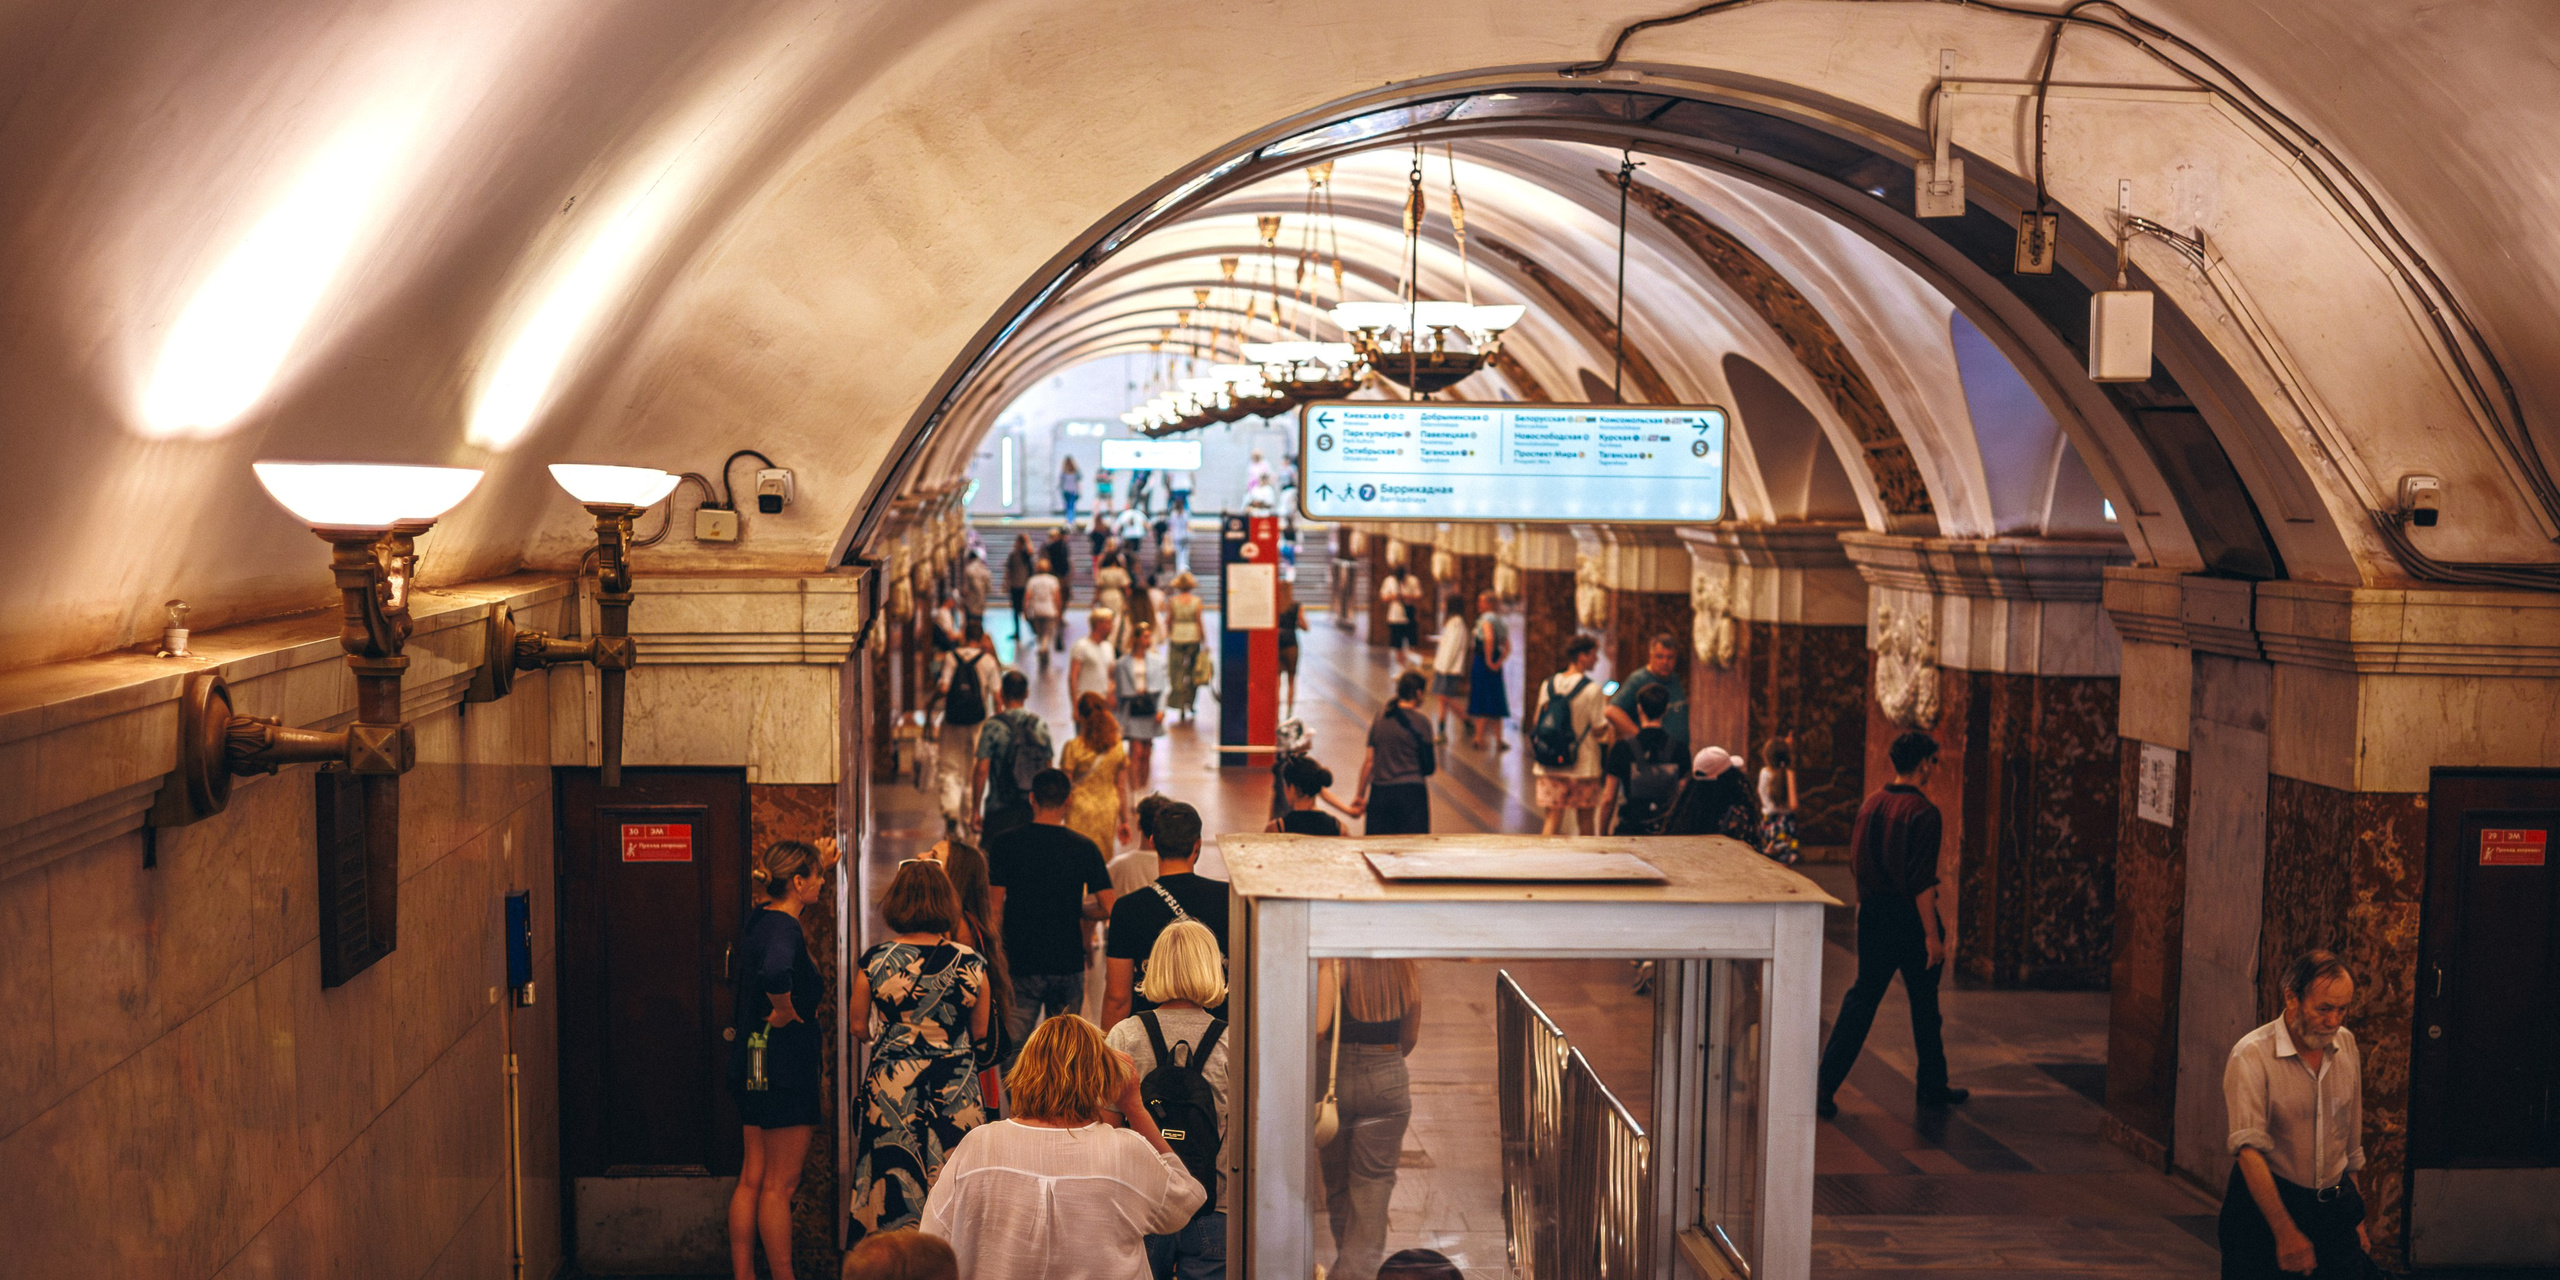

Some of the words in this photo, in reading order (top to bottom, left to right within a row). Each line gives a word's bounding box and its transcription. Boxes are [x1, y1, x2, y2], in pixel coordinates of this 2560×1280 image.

[1420, 413, 1481, 421] Добрынинская
[1515, 414, 1565, 422] Белорусская
[1599, 416, 1663, 424] Комсомольская
[1343, 429, 1364, 438] Парк
[1366, 431, 1403, 439] культуры
[1420, 430, 1469, 439] Павелецкая
[1514, 432, 1582, 441] Новослободская
[1599, 434, 1632, 442] Курская
[1343, 447, 1395, 455] Октябрьская
[1420, 448, 1460, 456] Таганская
[1514, 450, 1552, 458] Проспект
[1555, 451, 1577, 459] Мира
[1599, 451, 1637, 459] Таганская
[1381, 483, 1453, 495] Баррикадная
